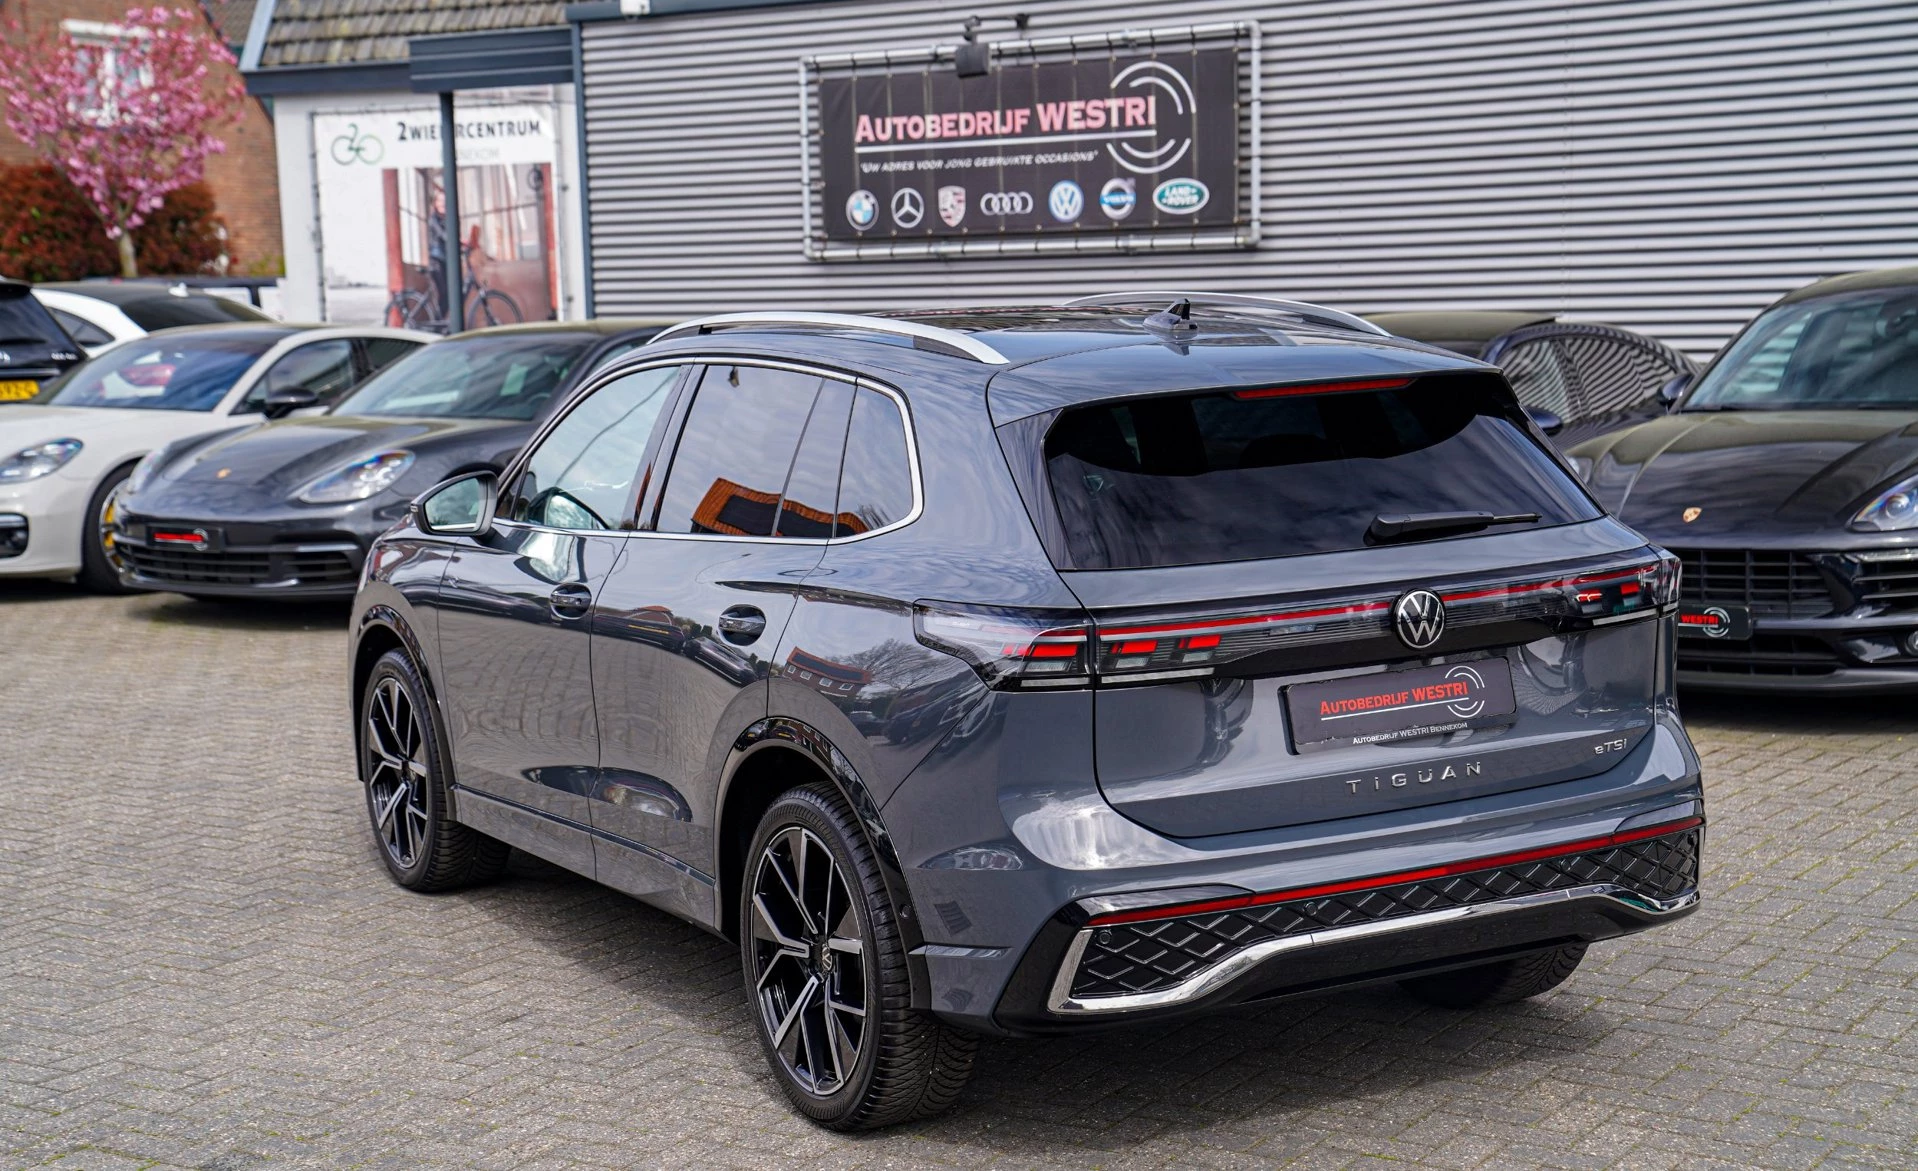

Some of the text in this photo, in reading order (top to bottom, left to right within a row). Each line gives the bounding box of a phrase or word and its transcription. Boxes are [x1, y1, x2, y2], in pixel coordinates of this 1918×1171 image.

[855, 95, 1156, 143] AUTOBEDRIJF WESTRI
[397, 120, 541, 142] 2WIERCENTRUM
[881, 160, 915, 172] ADRES
[916, 158, 943, 171] VOOR
[944, 157, 973, 170] JONG
[973, 153, 1033, 168] GEBRUIKTE
[1681, 614, 1719, 625] WESTRI
[1320, 681, 1468, 716] AUTOBEDRIJF WESTRI
[1353, 722, 1468, 744] AUTOBEDRIJF WESTRI BENNEKOM
